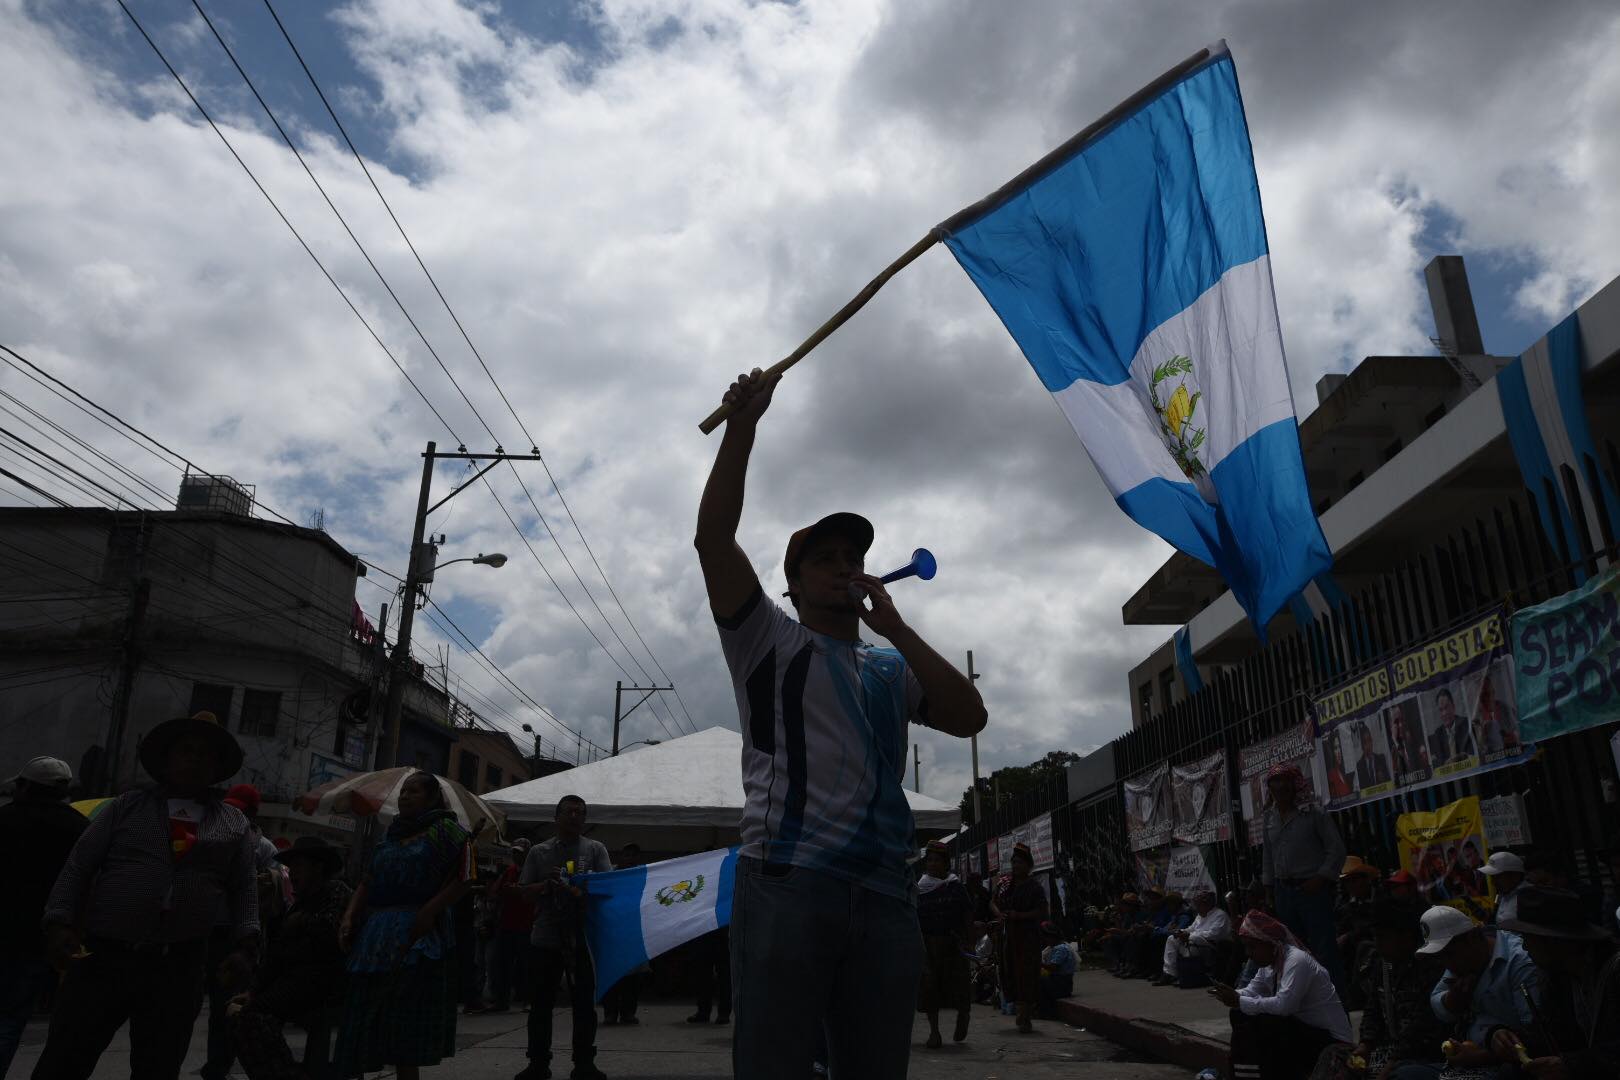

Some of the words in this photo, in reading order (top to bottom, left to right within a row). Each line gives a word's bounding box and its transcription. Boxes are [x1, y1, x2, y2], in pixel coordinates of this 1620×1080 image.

[1317, 671, 1388, 719] MALDITOS
[1394, 618, 1504, 685] GOLPISTAS
[1290, 742, 1314, 758] LUCHA
